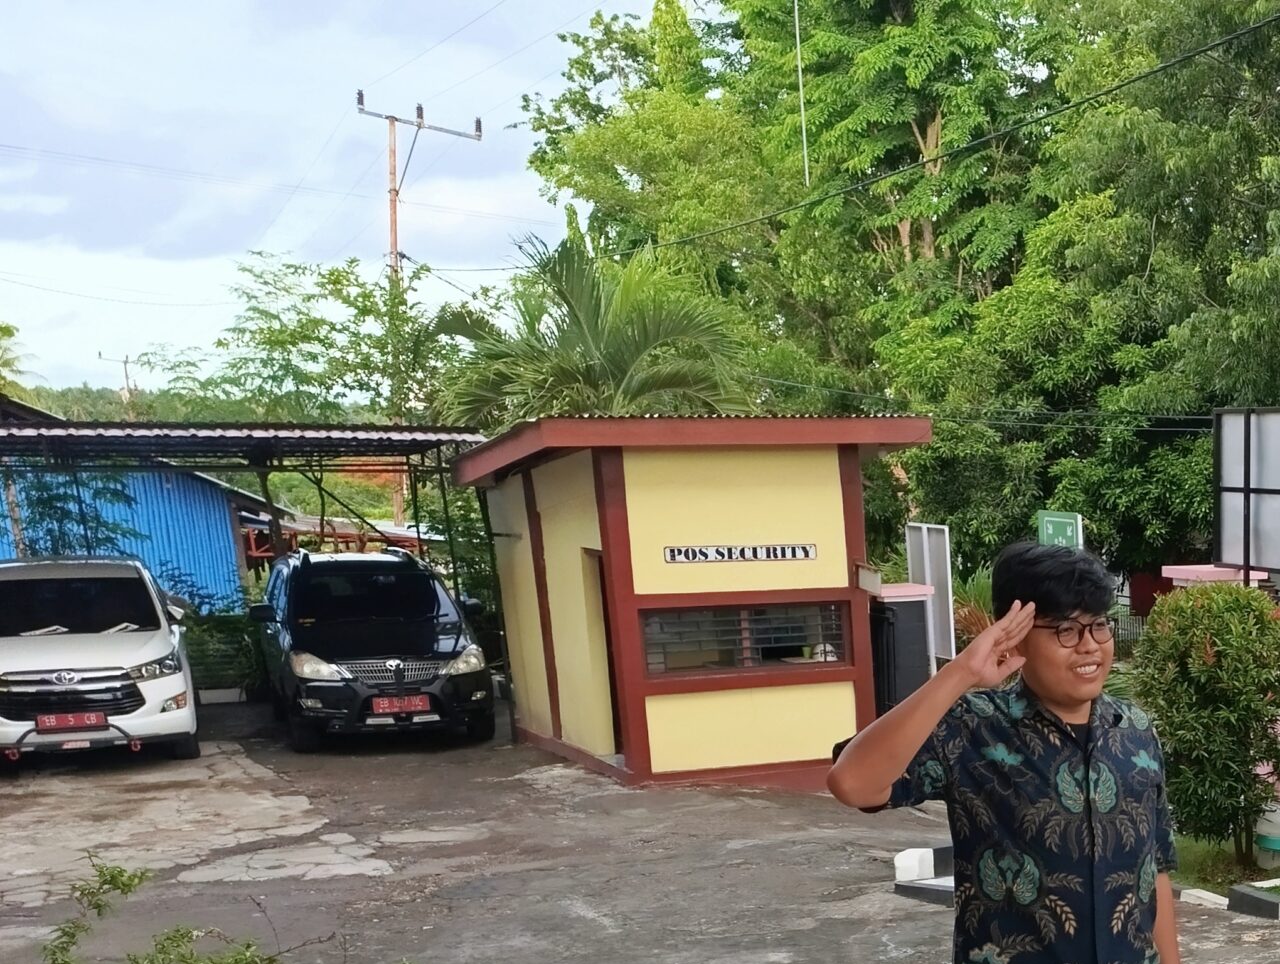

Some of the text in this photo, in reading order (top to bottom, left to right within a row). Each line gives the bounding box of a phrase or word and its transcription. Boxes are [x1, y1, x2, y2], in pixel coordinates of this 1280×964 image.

[669, 546, 813, 561] POS SECURITY
[45, 715, 57, 726] EB
[84, 713, 97, 724] CB
